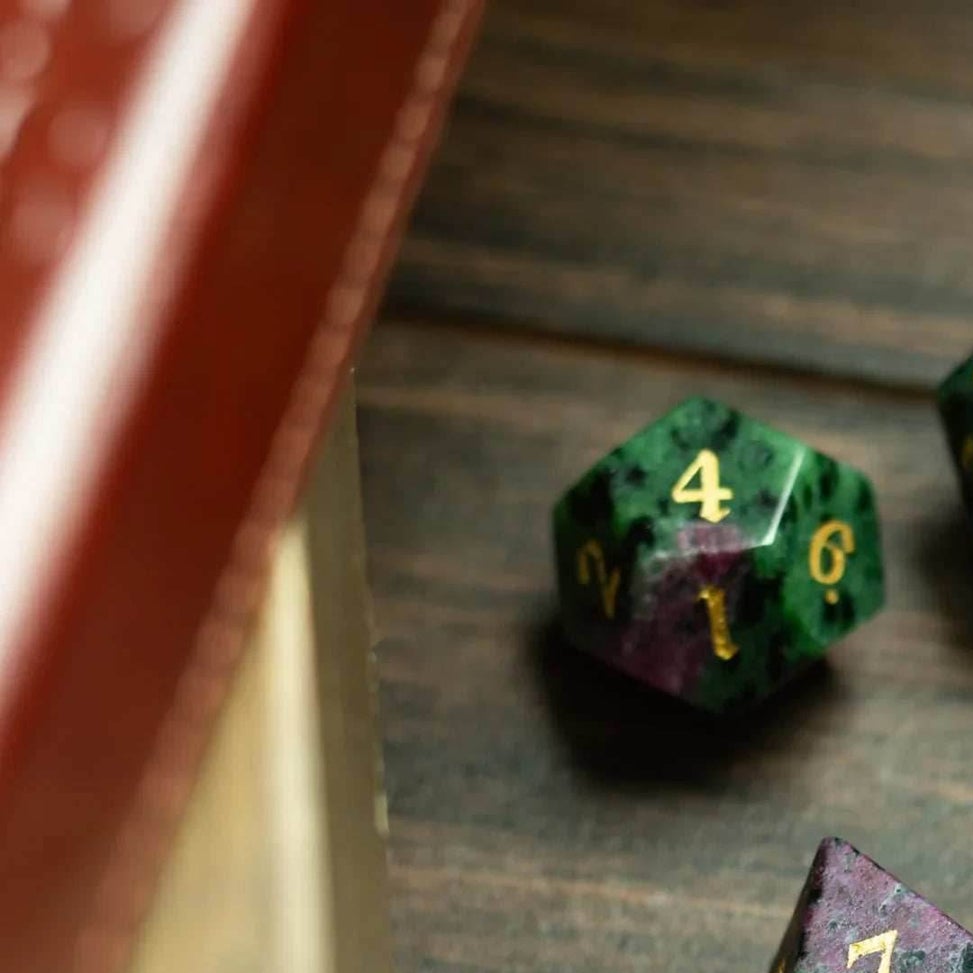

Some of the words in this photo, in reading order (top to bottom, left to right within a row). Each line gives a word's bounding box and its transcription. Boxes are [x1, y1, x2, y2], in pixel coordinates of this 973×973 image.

[671, 449, 733, 523] 4
[577, 541, 621, 619] 2
[699, 585, 739, 660] 1
